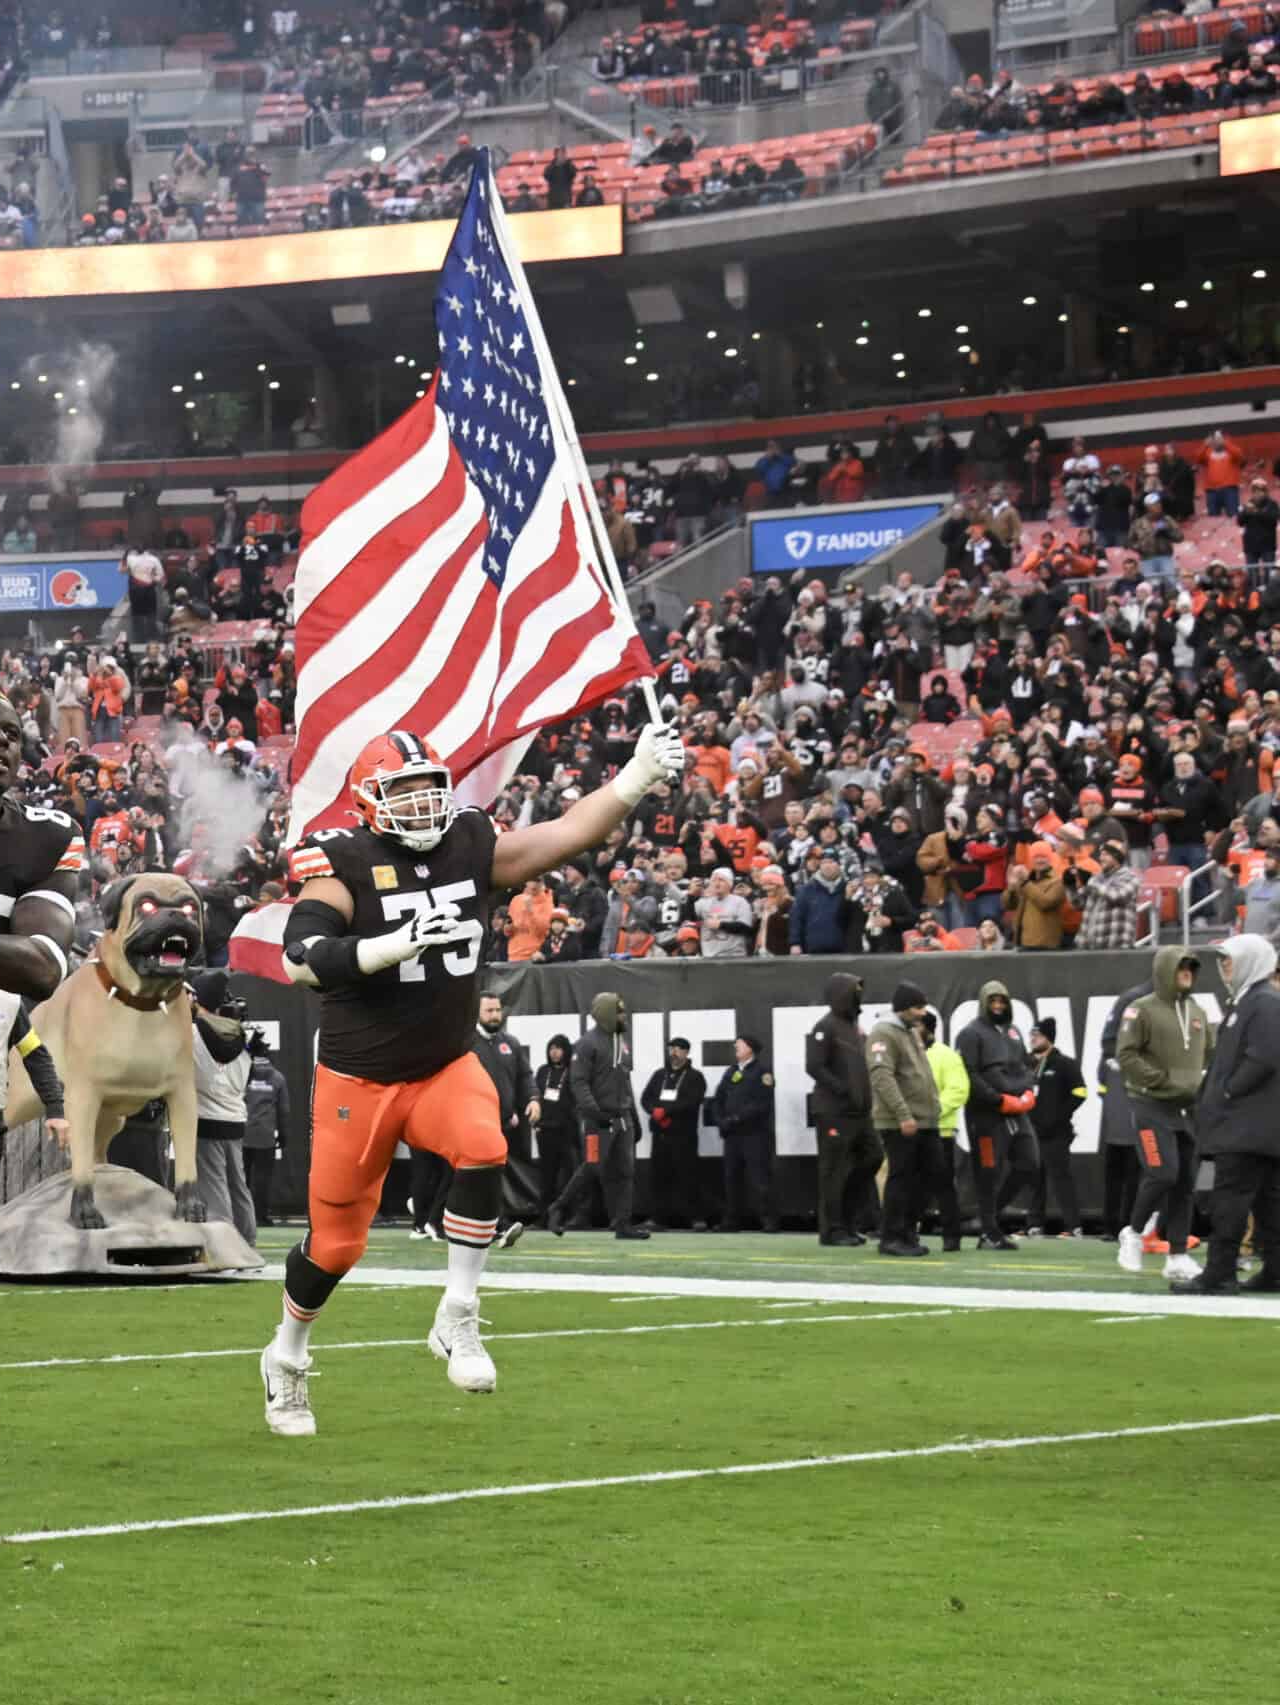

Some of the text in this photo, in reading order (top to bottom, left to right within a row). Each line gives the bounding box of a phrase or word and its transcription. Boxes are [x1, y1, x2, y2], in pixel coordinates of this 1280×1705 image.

[1, 576, 31, 586] BUD
[655, 813, 675, 834] 21
[381, 879, 484, 982] 75
